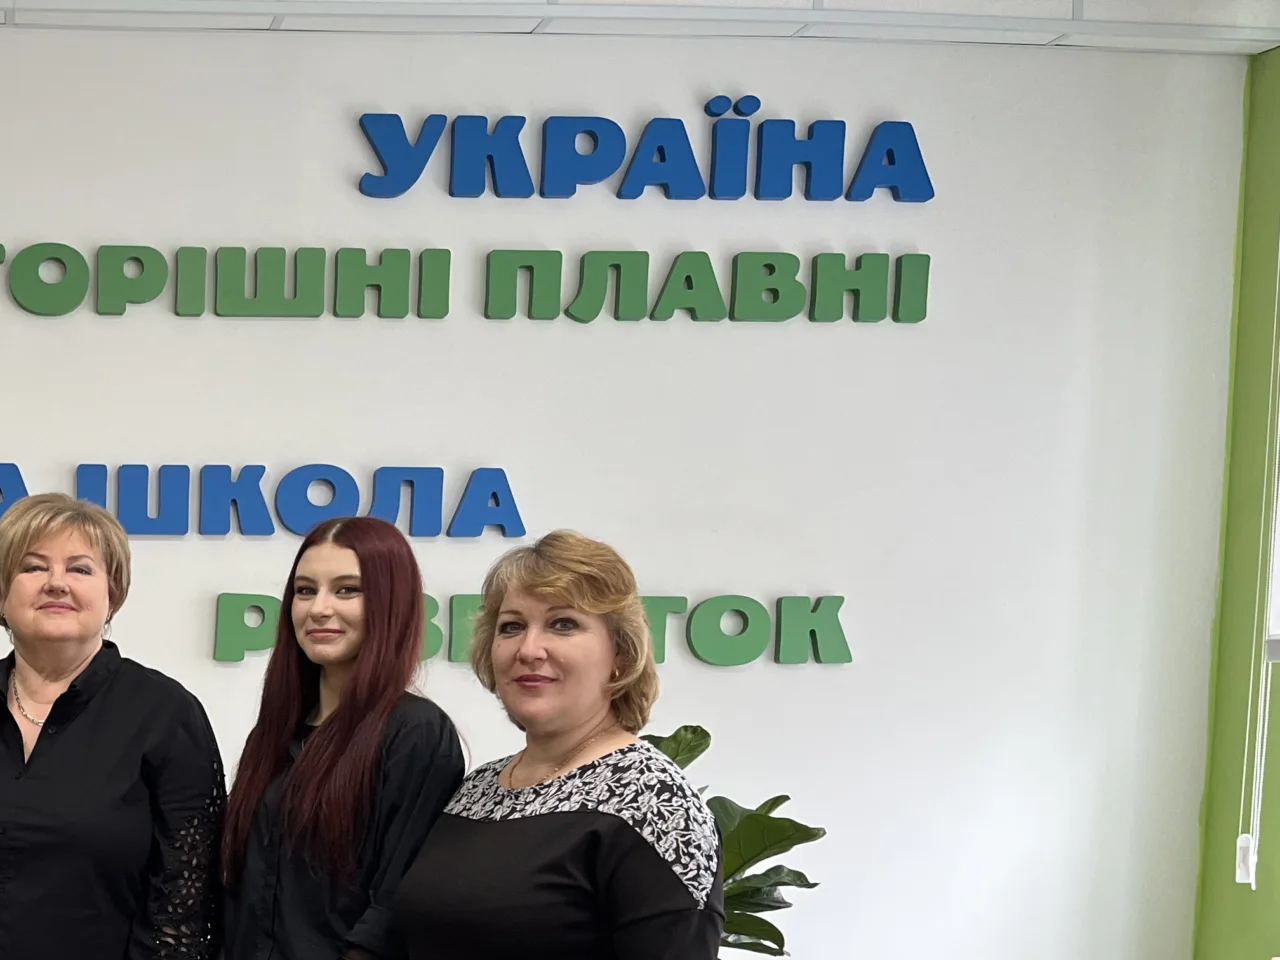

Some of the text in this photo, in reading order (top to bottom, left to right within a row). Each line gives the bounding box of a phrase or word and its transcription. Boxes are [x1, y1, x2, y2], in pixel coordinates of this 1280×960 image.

[358, 94, 935, 203] УКРАЇНА
[484, 249, 931, 323] ПЛАВНІ
[76, 463, 526, 537] ШКОЛА
